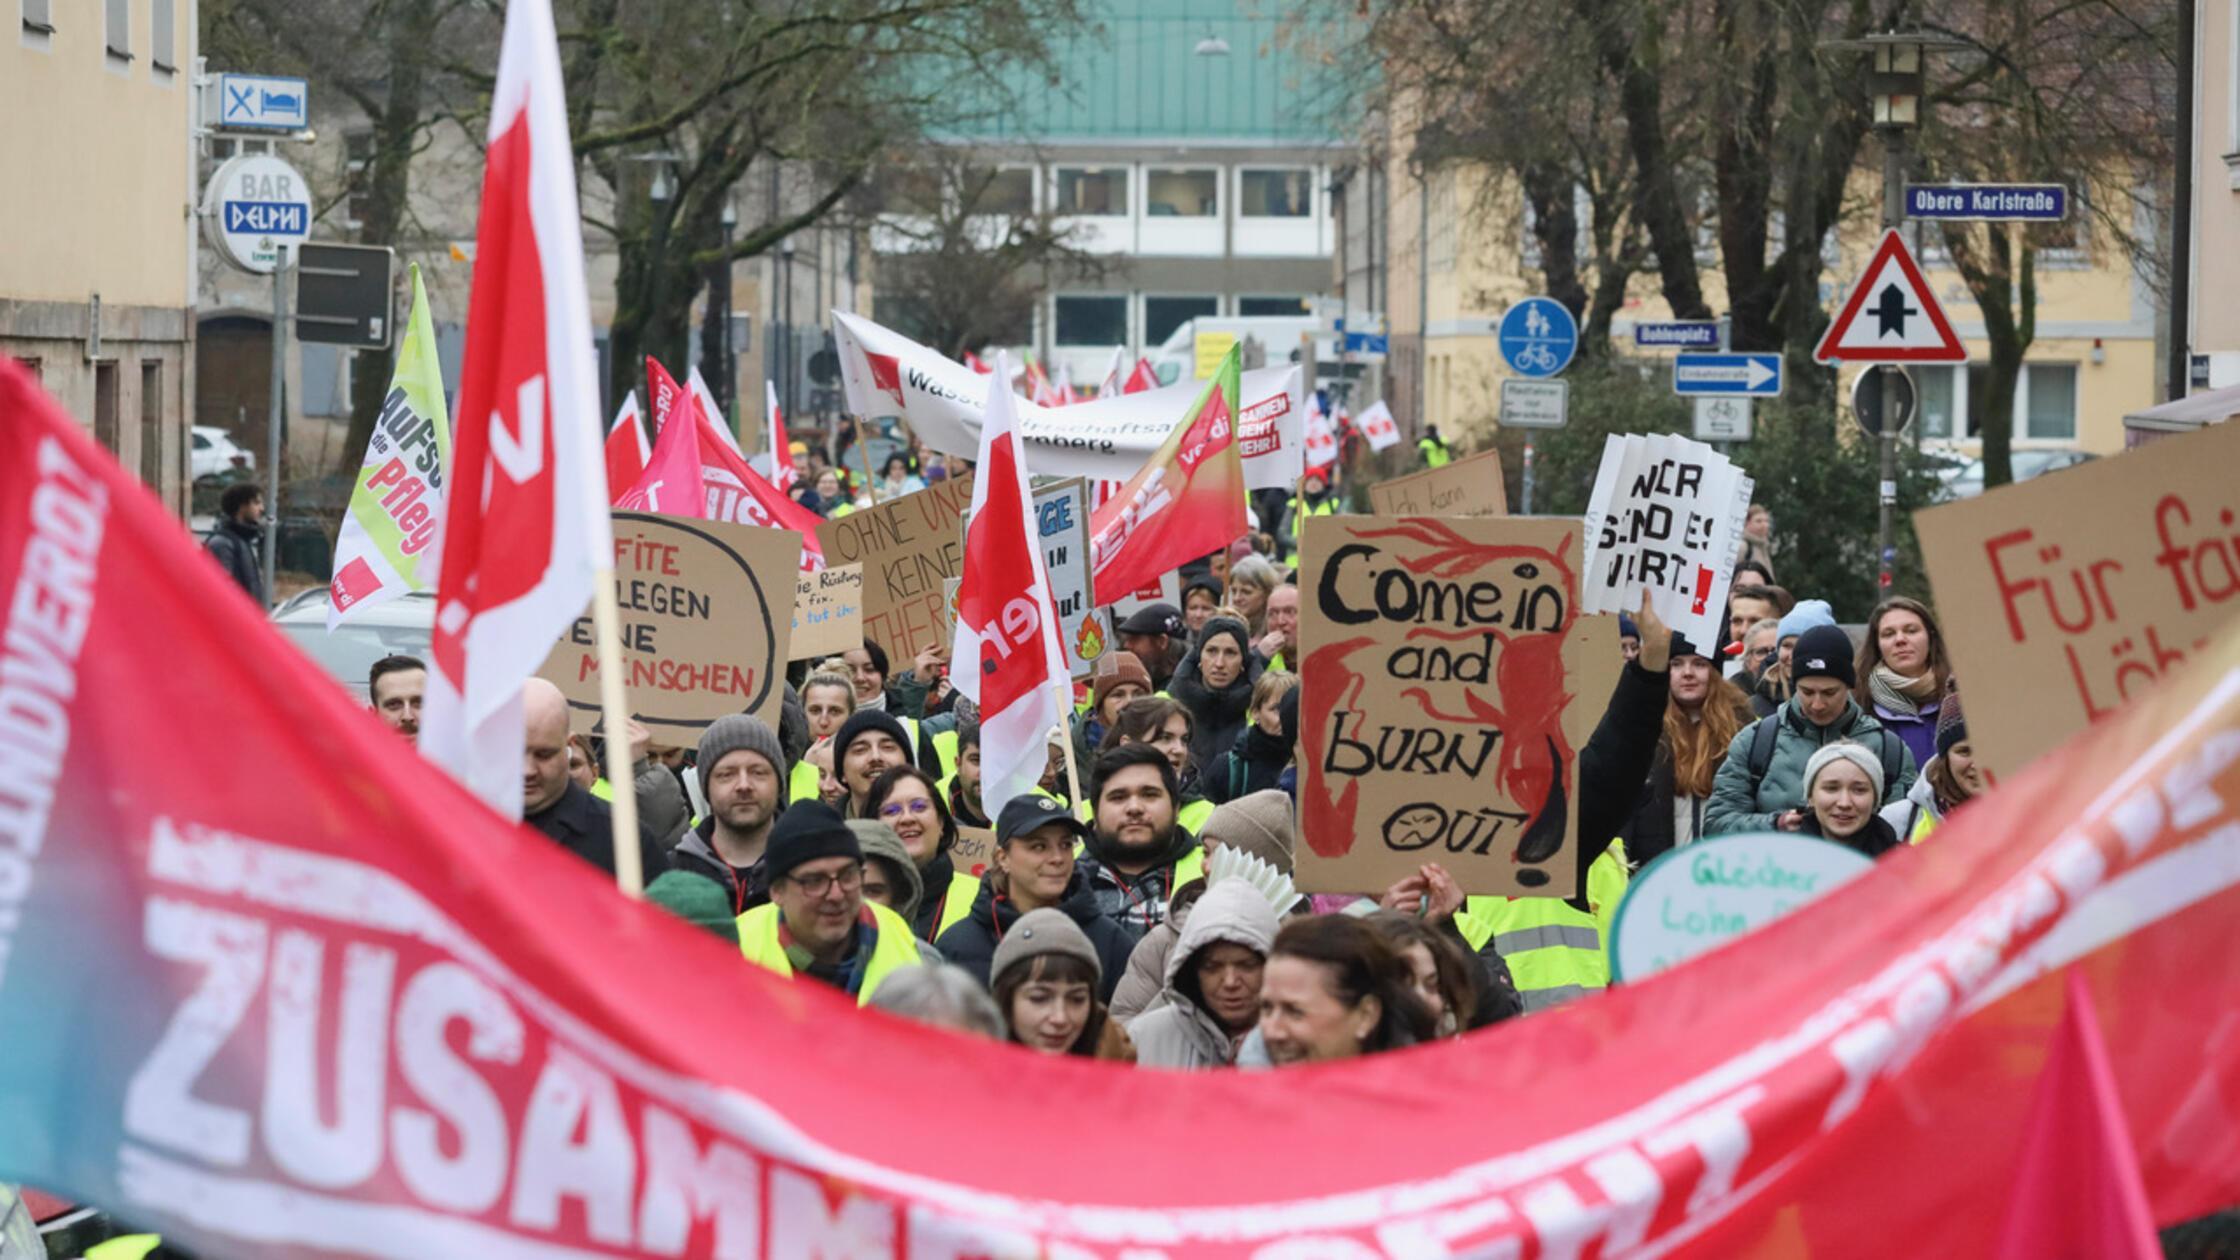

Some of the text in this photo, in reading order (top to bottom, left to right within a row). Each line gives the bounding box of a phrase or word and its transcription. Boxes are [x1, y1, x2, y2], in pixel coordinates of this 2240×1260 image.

[241, 174, 292, 199] BAR
[1916, 190, 2055, 211] Obere Karlstraße
[232, 203, 300, 231] DELPHI
[1387, 481, 1466, 515] Ich kann
[835, 502, 915, 562] OHNE
[614, 533, 680, 577] FITE
[1984, 492, 2240, 644] Für fai
[616, 580, 711, 620] LEGEN
[797, 578, 812, 594] ie
[1318, 543, 1564, 633] Come in
[863, 592, 947, 663] THER
[579, 654, 754, 699] MNSCHEN
[1386, 632, 1496, 685] and
[1660, 896, 1747, 934] Lohn
